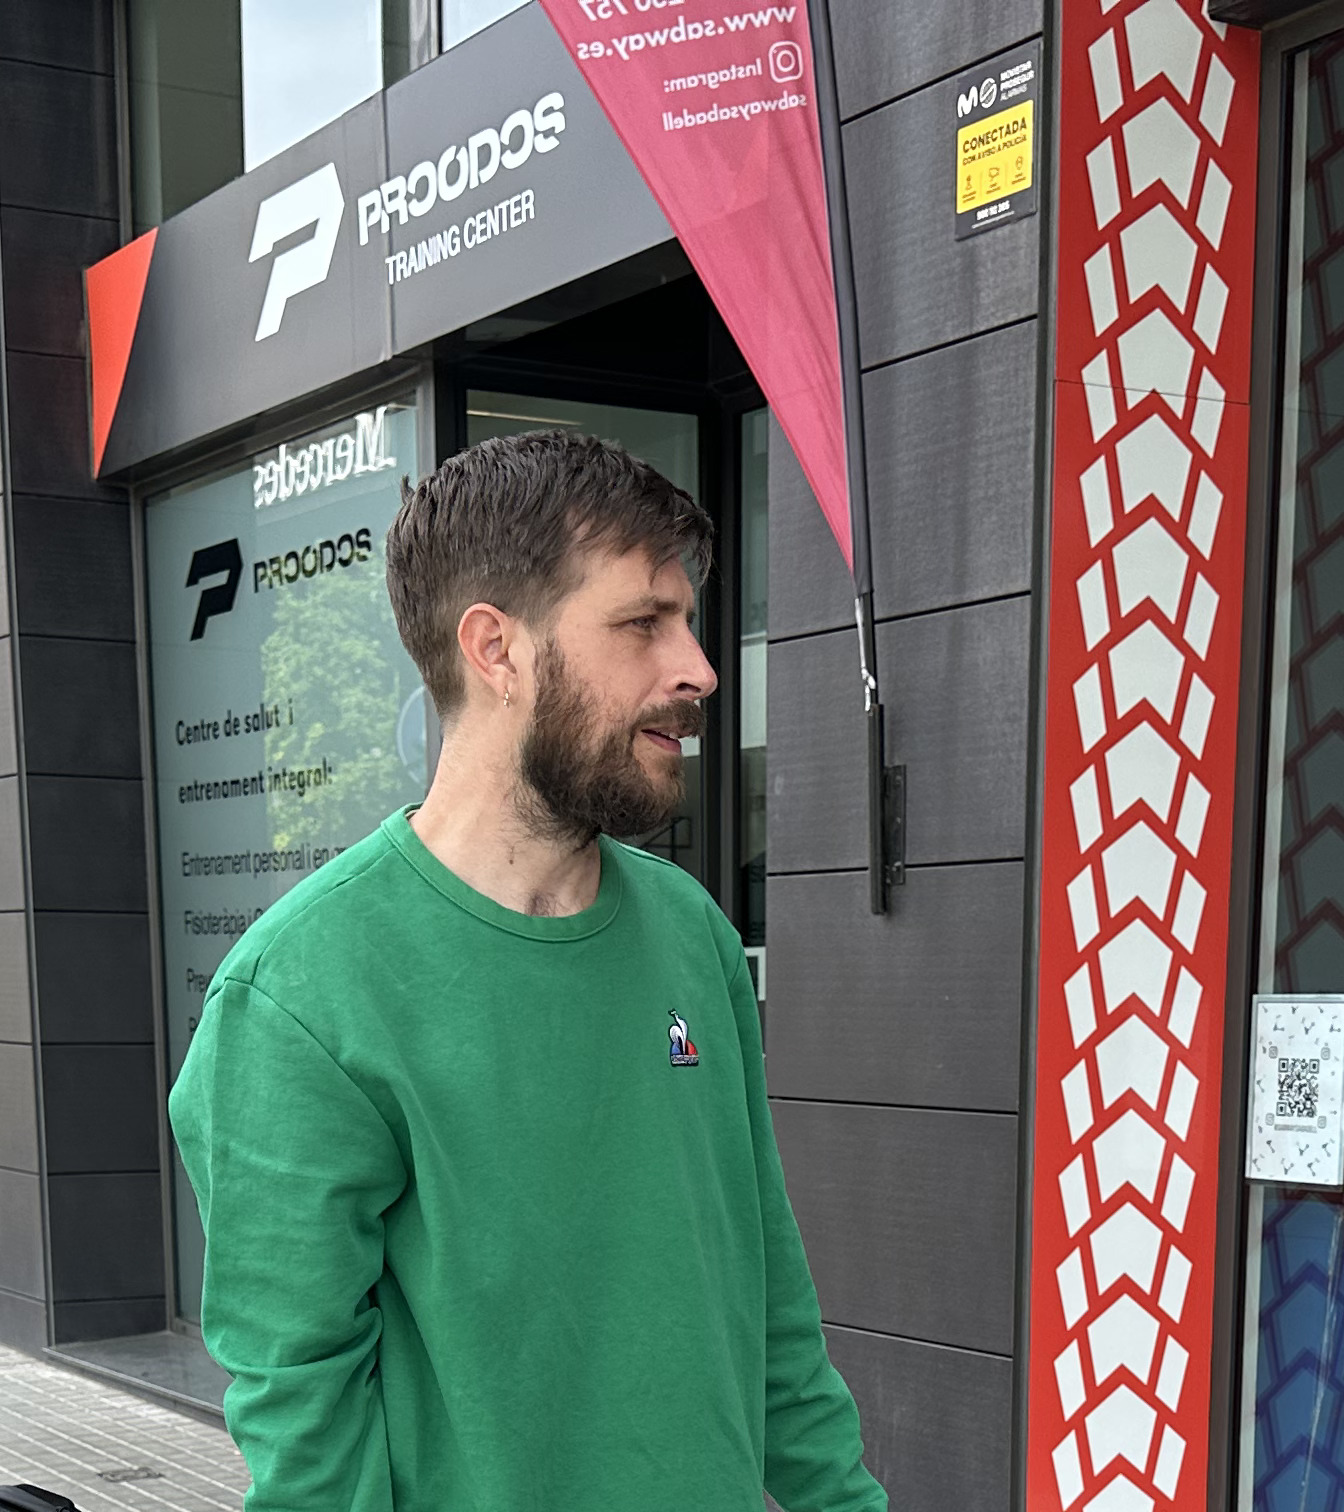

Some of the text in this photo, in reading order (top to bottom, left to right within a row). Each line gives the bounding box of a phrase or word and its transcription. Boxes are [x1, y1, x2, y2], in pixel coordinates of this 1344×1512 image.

[962, 116, 1027, 153] CONECTADA
[357, 92, 567, 246] PROODOS
[385, 189, 536, 285] TRAINING CENTER
[253, 527, 372, 593] PROODOS
[175, 717, 220, 747] Centre
[223, 708, 241, 738] de
[244, 702, 280, 736] salut
[178, 756, 334, 805] entrenament integral:
[182, 848, 252, 878] Entrenament
[252, 843, 306, 879] personal
